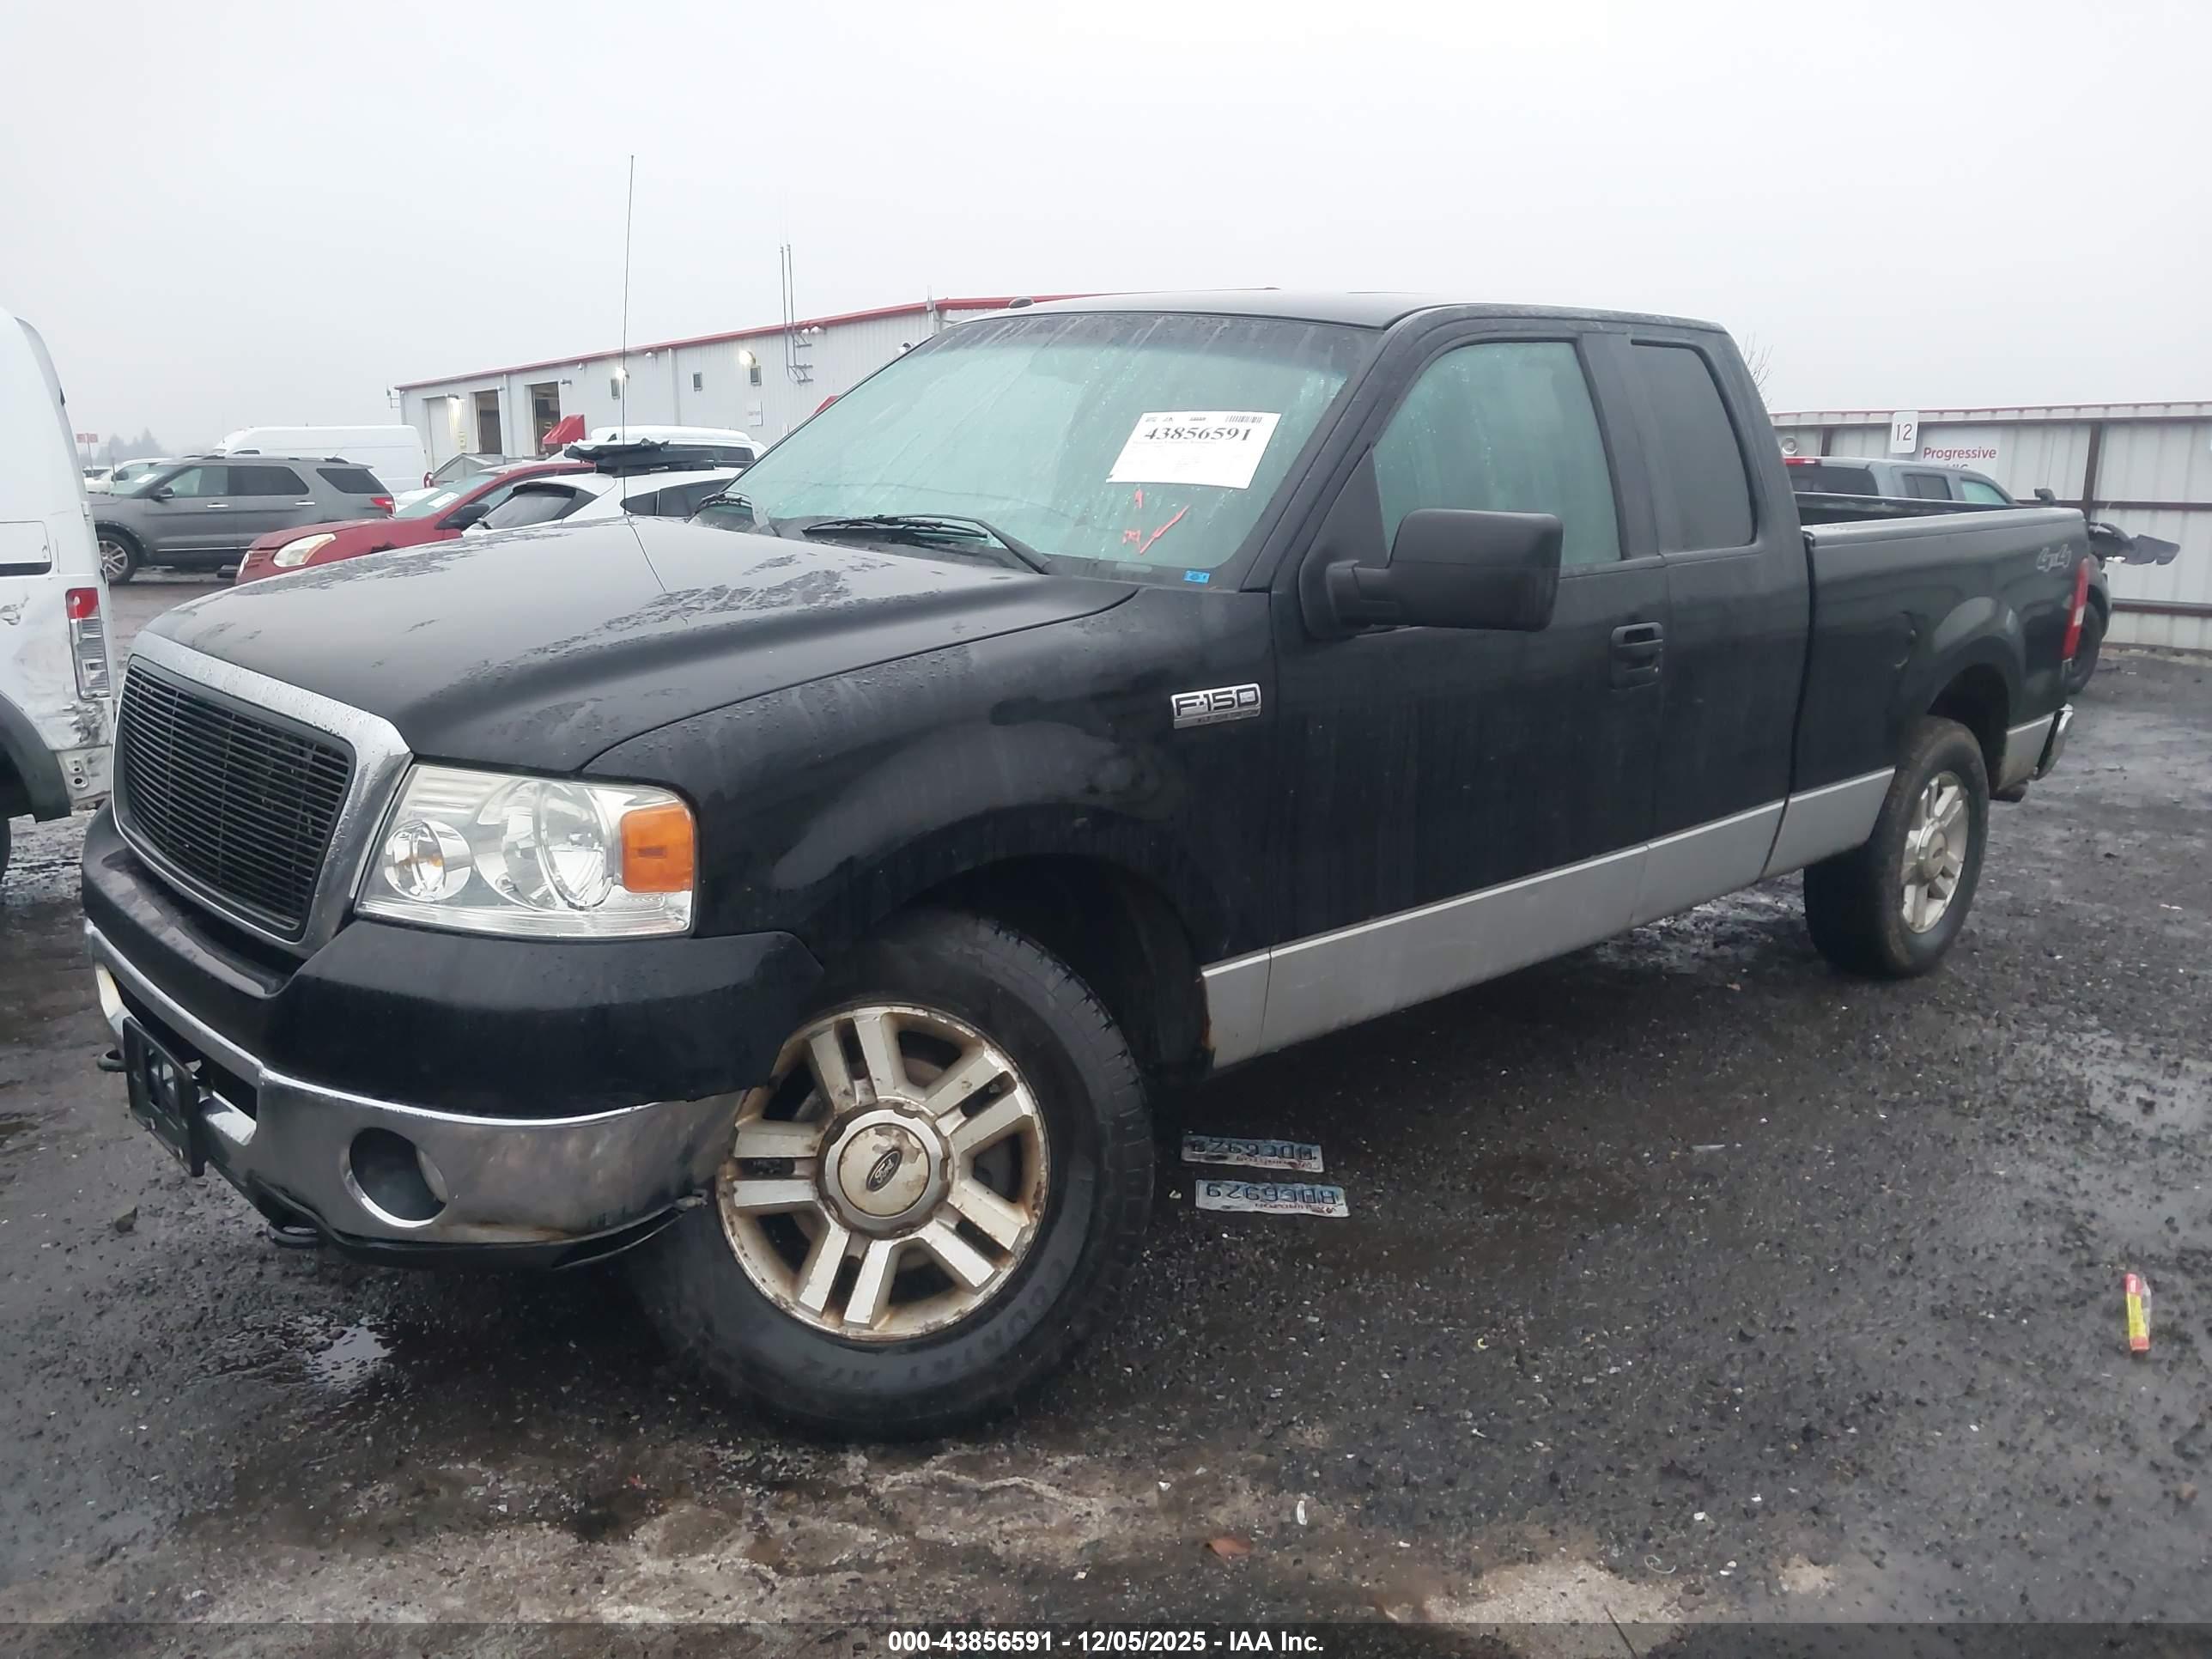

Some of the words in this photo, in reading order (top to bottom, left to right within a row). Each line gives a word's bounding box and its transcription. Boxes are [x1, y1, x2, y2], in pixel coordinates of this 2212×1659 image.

[1145, 427, 1251, 441] 43856591
[1896, 423, 1913, 441] 12
[1923, 447, 1996, 461] Progressive
